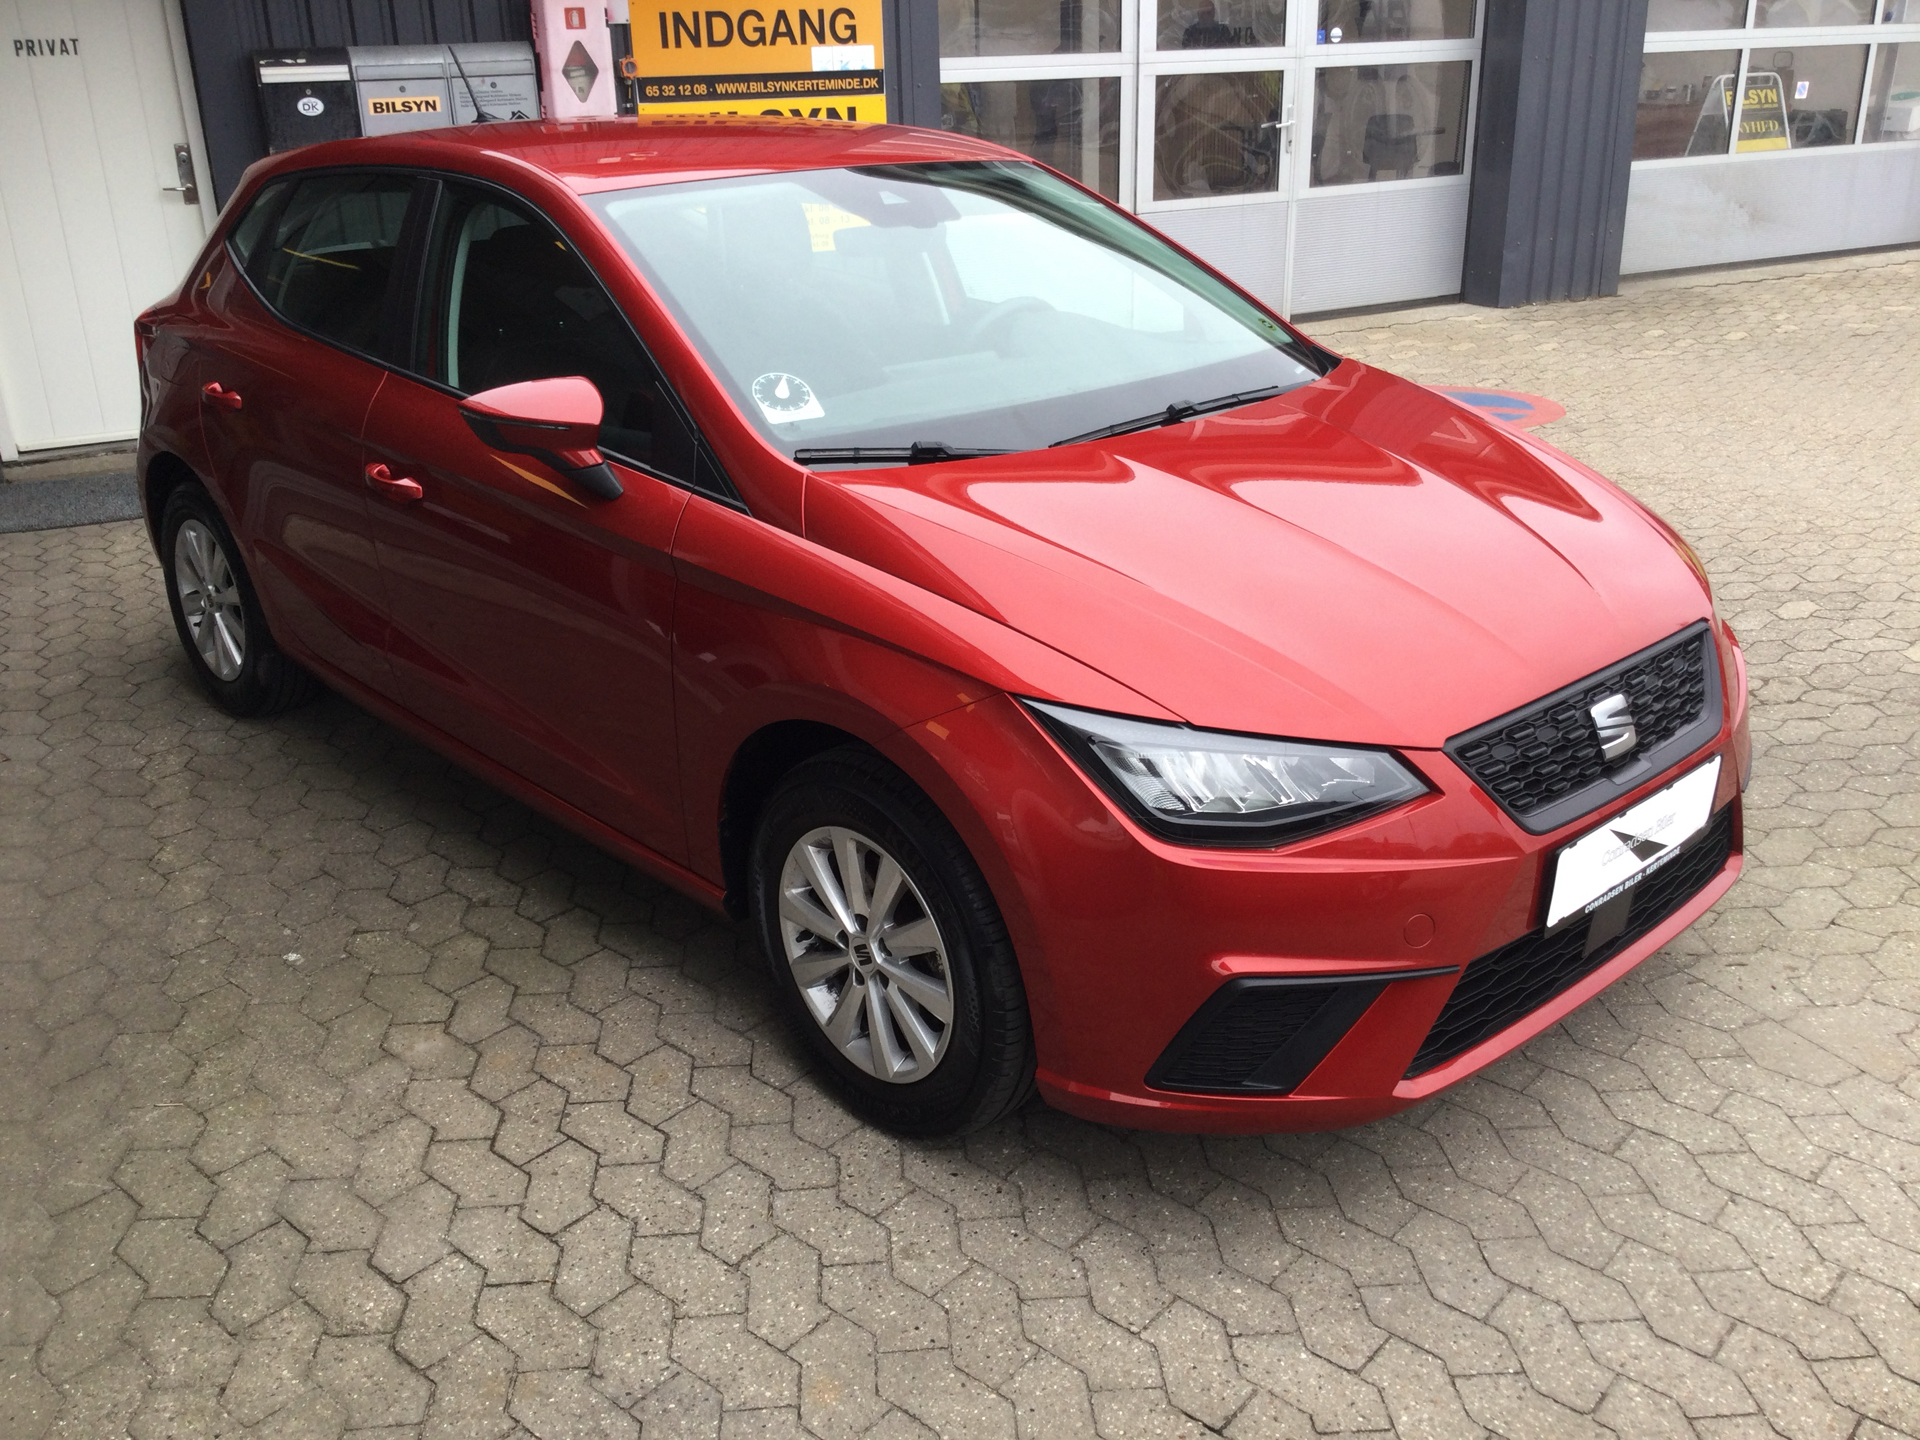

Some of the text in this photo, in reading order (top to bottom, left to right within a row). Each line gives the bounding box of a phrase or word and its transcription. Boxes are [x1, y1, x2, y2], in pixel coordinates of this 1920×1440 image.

[658, 7, 857, 49] INDGANG
[13, 38, 79, 57] PRIVAT
[645, 85, 660, 97] 65
[661, 85, 676, 96] 32
[678, 84, 692, 96] 12
[693, 84, 708, 95] 08
[715, 77, 879, 95] WWW.BILSYNKERTEMINDE.DK
[302, 102, 319, 111] DK
[372, 100, 437, 114] BILSYN
[1584, 884, 1624, 914] CONRADSEN
[1624, 872, 1643, 890] BILER
[1645, 846, 1681, 876] KERTEMINDE
